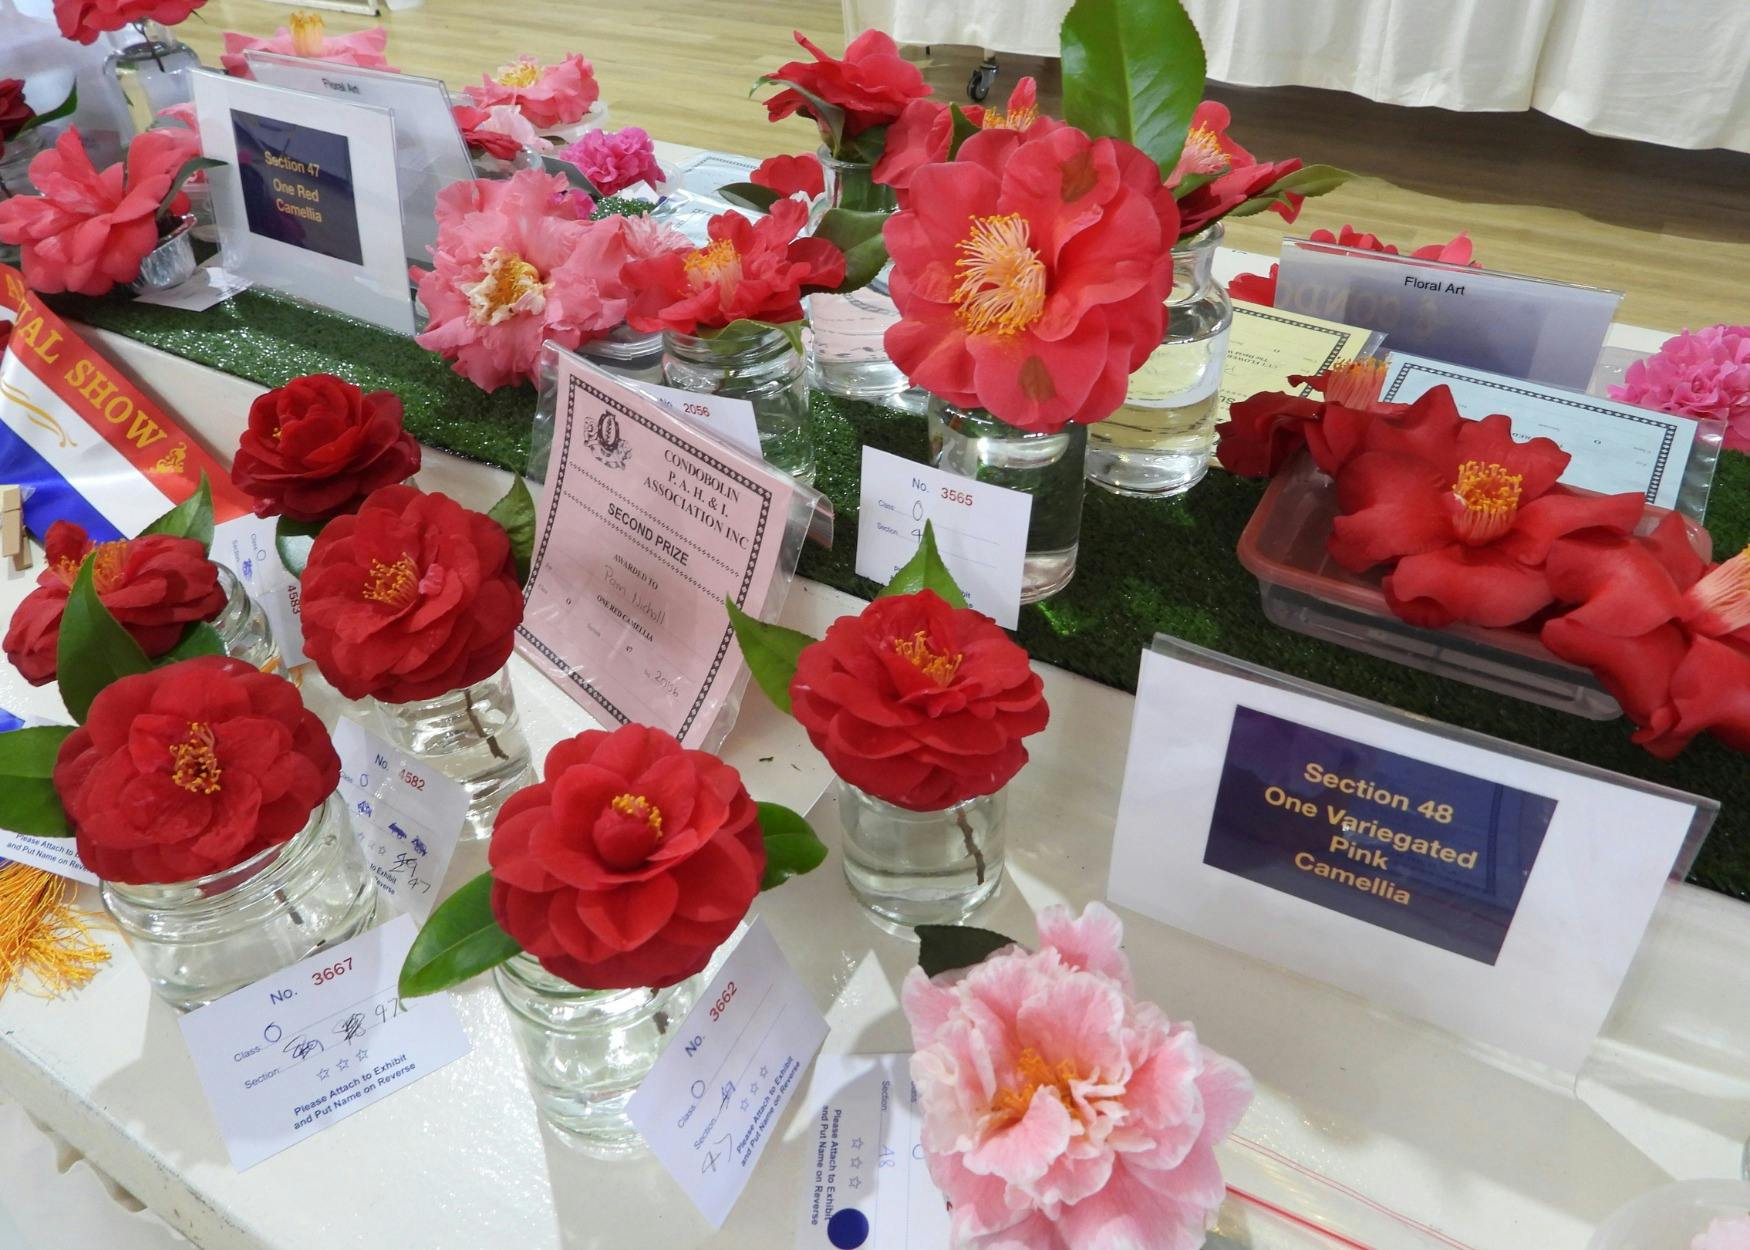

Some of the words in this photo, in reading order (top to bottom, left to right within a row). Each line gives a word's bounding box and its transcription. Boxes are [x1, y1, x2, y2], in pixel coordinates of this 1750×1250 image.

[264, 151, 305, 174] Section
[307, 163, 320, 177] 47
[273, 178, 294, 195] One
[297, 185, 319, 202] Red
[276, 198, 322, 222] Camellia
[1404, 276, 1441, 291] Floral
[1445, 283, 1465, 295] Art
[64, 359, 167, 448] SHOW
[683, 402, 710, 417] 2056
[664, 449, 740, 502] CONDOBOLIN
[708, 497, 717, 511] &
[912, 478, 930, 493] No.
[941, 487, 973, 506] 3565
[643, 477, 723, 533] ASSOCIATION
[726, 527, 749, 550] INC
[608, 502, 653, 541] SECOND
[655, 535, 689, 566] PRIZE
[614, 554, 648, 581] AWARDED
[648, 578, 658, 590] TO
[288, 585, 301, 615] 4583
[596, 594, 609, 608] ONE
[609, 604, 622, 618] RED
[622, 614, 653, 642] CAMELLIA
[1304, 762, 1410, 812] Section
[1417, 800, 1454, 824] 48
[1264, 786, 1318, 818] One
[1326, 804, 1478, 870] Variegated
[6, 842, 21, 851] and
[22, 845, 36, 856] Put
[36, 850, 57, 861] Name
[58, 857, 68, 866] on
[41, 840, 65, 853] Attach
[65, 848, 73, 856] to
[1329, 835, 1389, 871] Pink
[375, 876, 395, 895] everse
[1294, 852, 1411, 905] Camellia
[270, 988, 298, 1005] No.
[311, 957, 354, 986] 3667
[685, 1034, 705, 1058] No.
[709, 981, 738, 1023] 3662
[234, 1045, 261, 1062] Class
[244, 1068, 280, 1089] Section
[293, 1095, 327, 1116] Please
[329, 1079, 361, 1099] Attach
[362, 1072, 372, 1081] to
[373, 1054, 407, 1076] Exhibit
[294, 1115, 313, 1130] and
[314, 1105, 333, 1119] Put
[333, 1090, 361, 1109] Name
[363, 1083, 377, 1094] on
[377, 1062, 416, 1087] Reverse
[737, 1124, 754, 1154] Please
[753, 1096, 770, 1123] Attach
[769, 1086, 776, 1096] to
[774, 1056, 794, 1085] Exhibit
[881, 1080, 890, 1111] Section
[678, 1104, 696, 1128] Class
[741, 1148, 752, 1167] and
[750, 1131, 761, 1148] Put
[759, 1107, 774, 1132] Name
[773, 1094, 781, 1106] on
[780, 1061, 800, 1094] Reverse
[821, 1105, 829, 1121] and
[832, 1109, 841, 1138] Please
[694, 1118, 717, 1150] Section
[820, 1124, 829, 1139] Put
[817, 1142, 827, 1168] Name
[829, 1141, 838, 1171] Attach
[816, 1170, 822, 1182] on
[828, 1174, 836, 1183] to
[811, 1185, 823, 1226] Reverse
[825, 1186, 836, 1220] Exhibit
